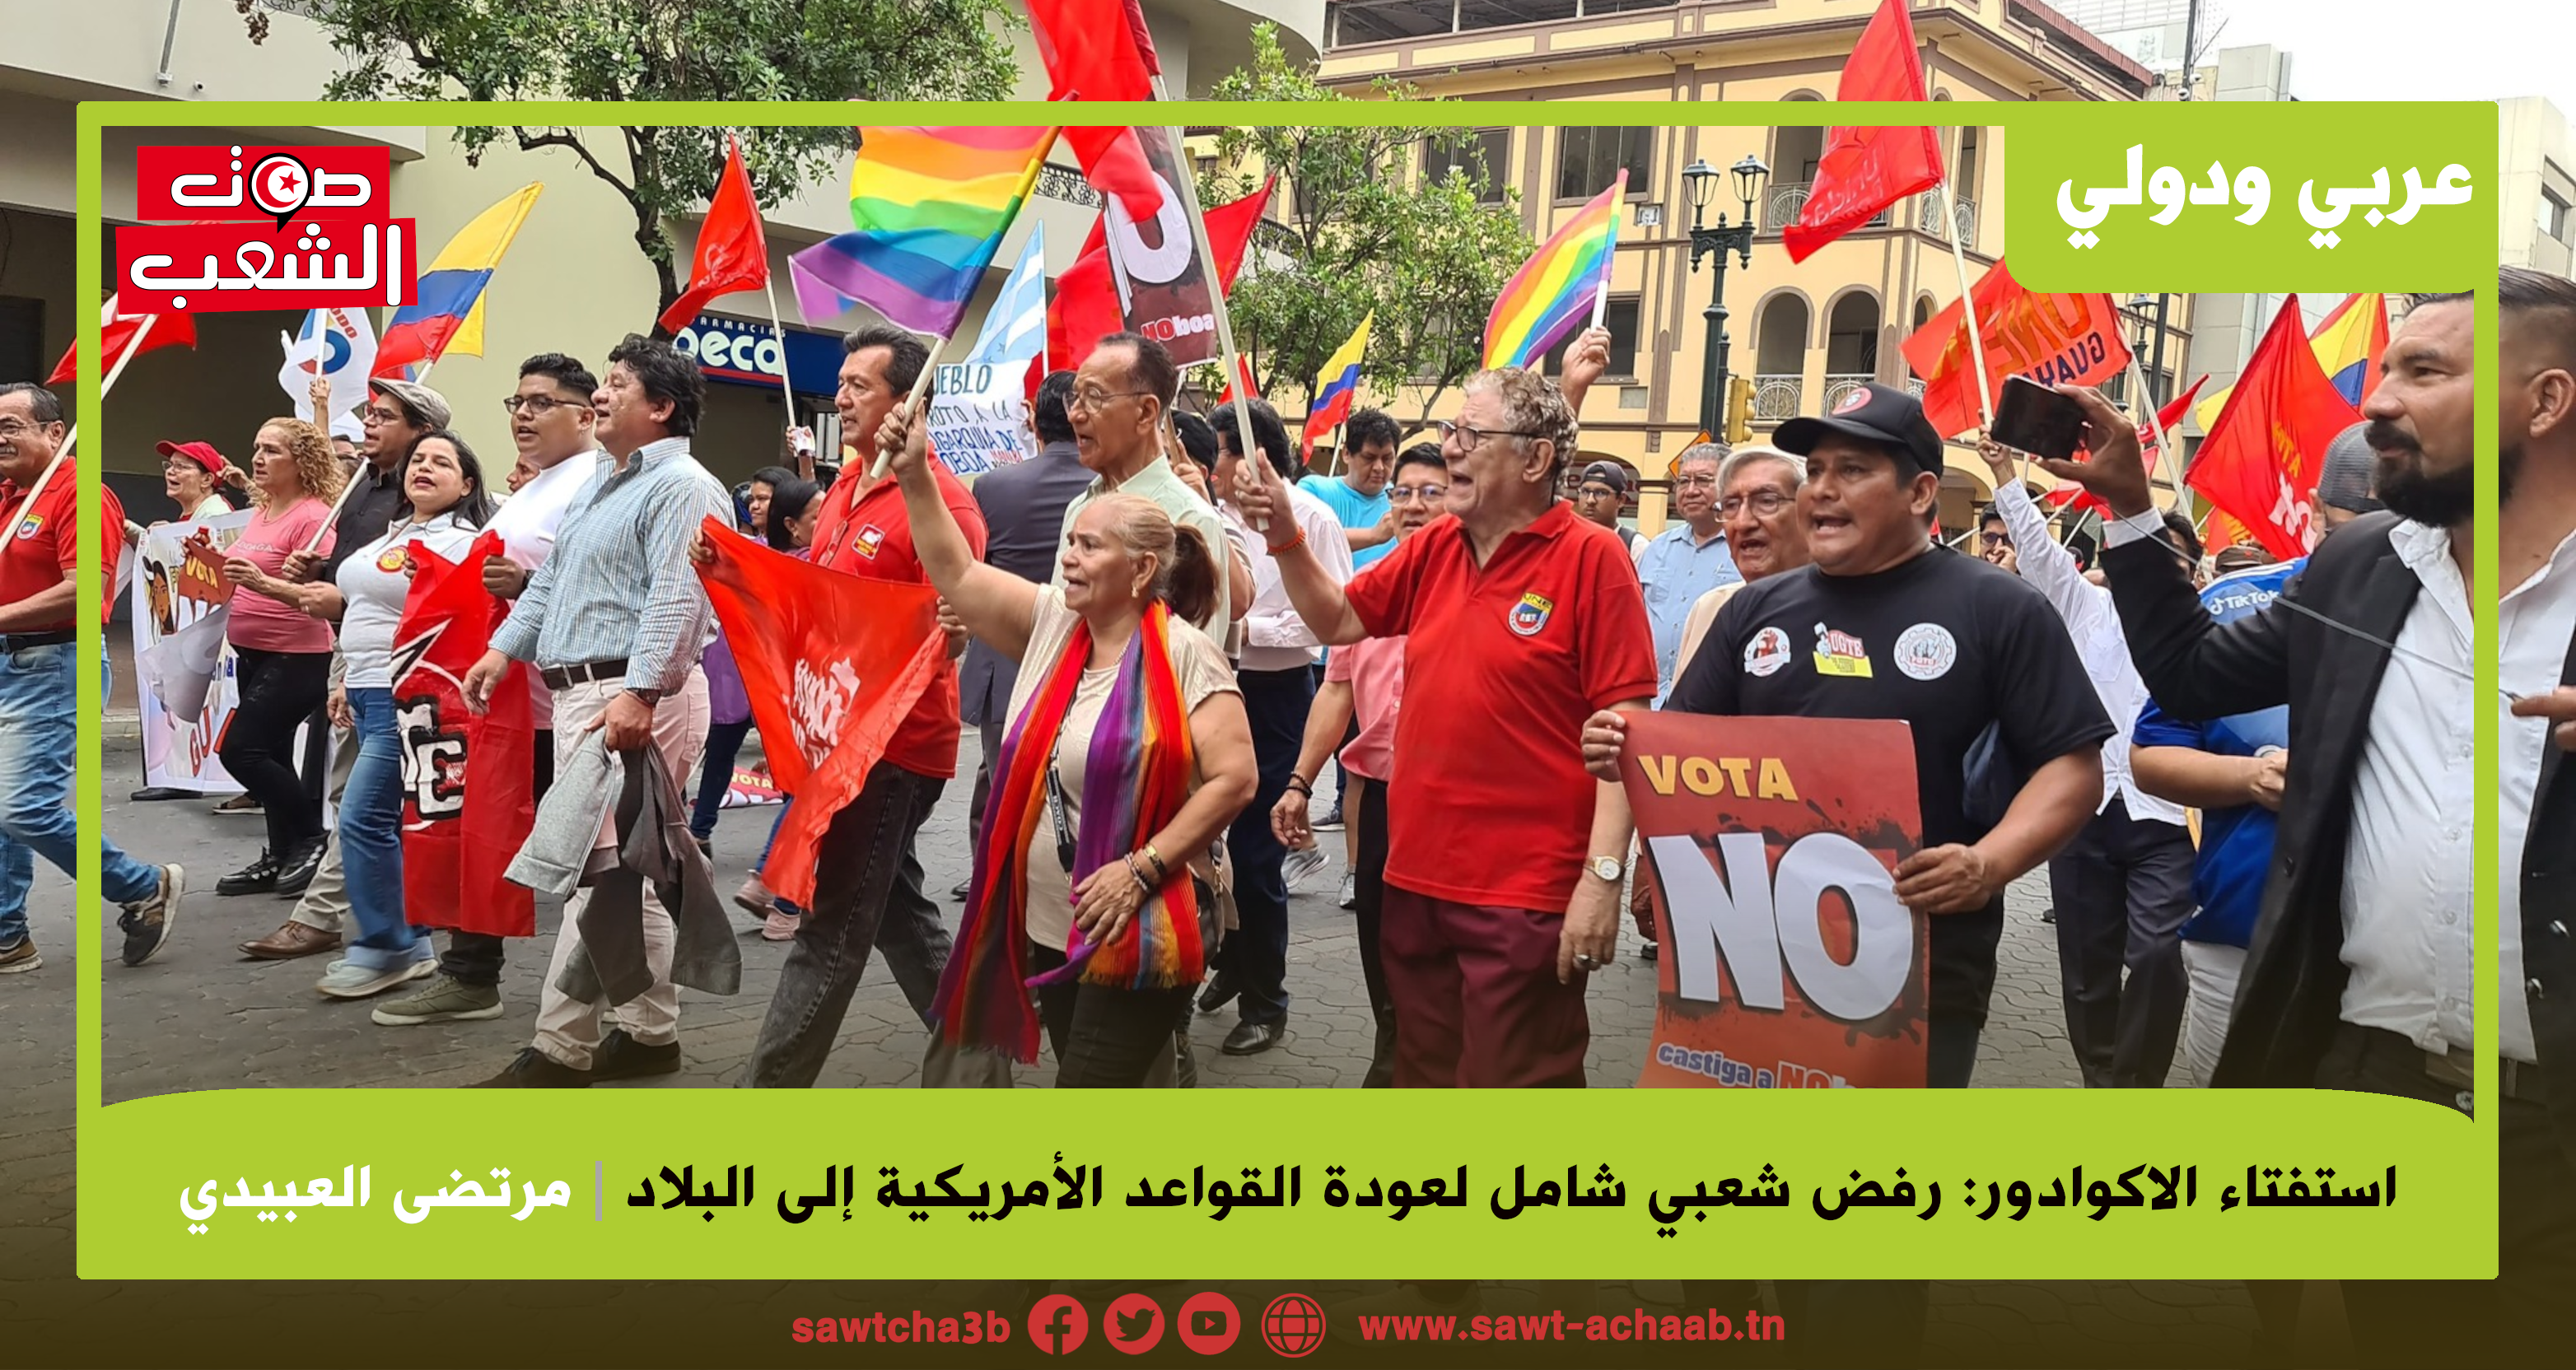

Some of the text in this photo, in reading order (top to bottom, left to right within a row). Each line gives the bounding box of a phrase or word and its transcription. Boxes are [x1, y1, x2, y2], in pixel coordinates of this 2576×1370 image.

[698, 316, 786, 338] ARMACIAS
[186, 557, 218, 589] VOTA
[2225, 590, 2280, 609] TikTok
[1638, 753, 1799, 802] VOTA
[1647, 832, 1915, 1023] NO
[1656, 1042, 1752, 1087] castiga
[1756, 1068, 1775, 1088] a
